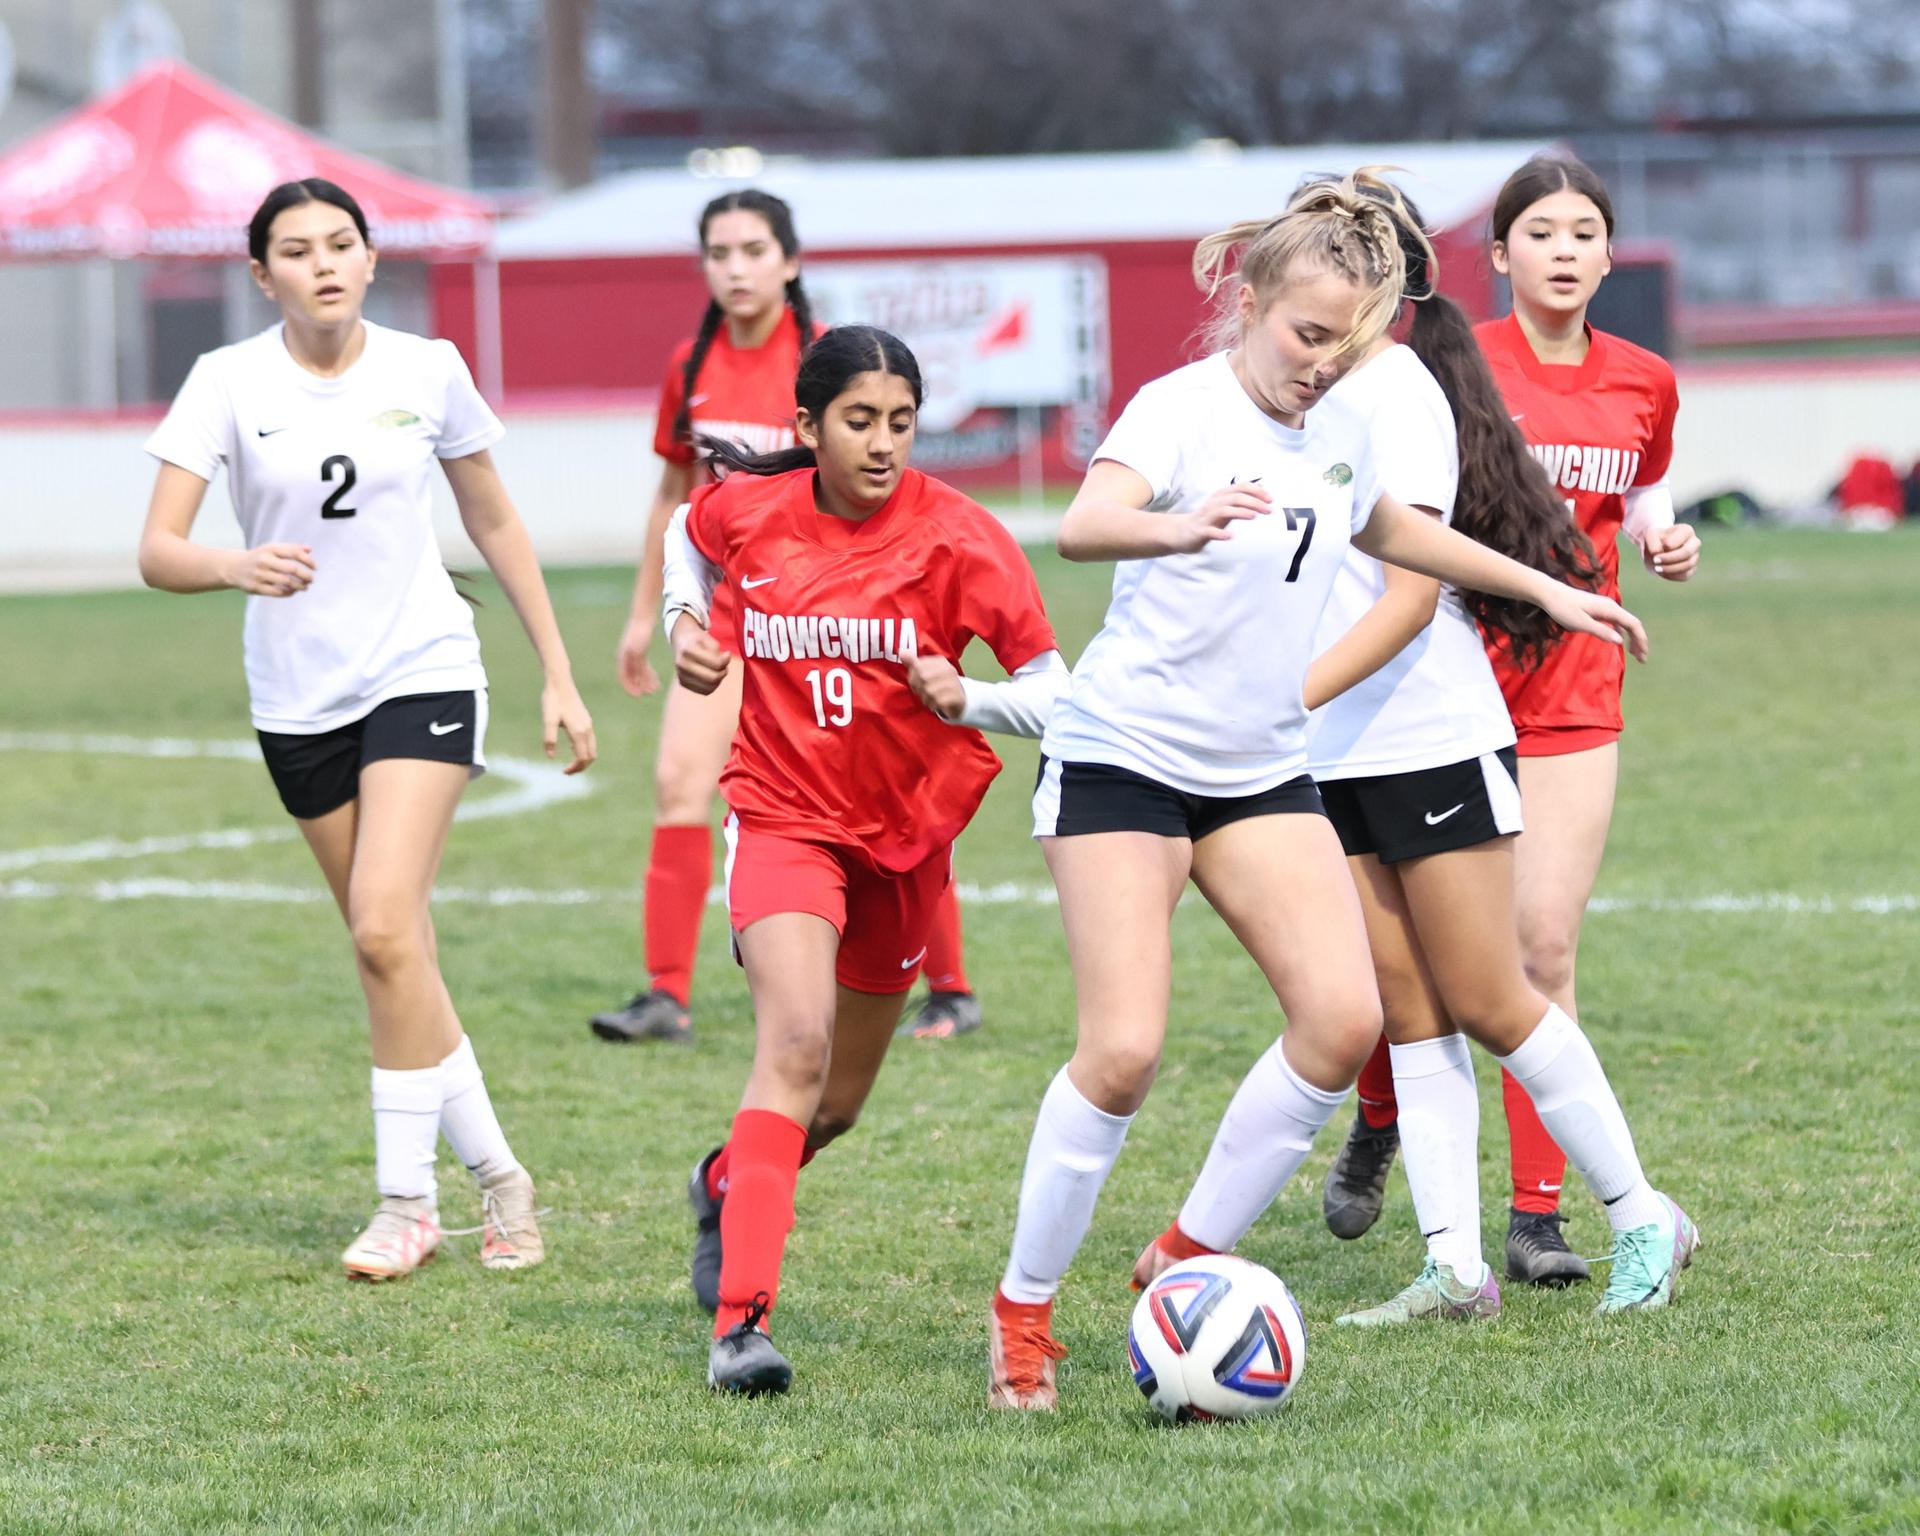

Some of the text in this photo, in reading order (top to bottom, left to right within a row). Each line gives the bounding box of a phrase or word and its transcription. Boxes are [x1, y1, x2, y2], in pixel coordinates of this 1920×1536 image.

[321, 454, 357, 519] 2
[1526, 445, 1639, 495] WCHILL
[1283, 507, 1317, 582] 7
[743, 607, 917, 664] CHOWCHILLA
[805, 667, 853, 728] 19
